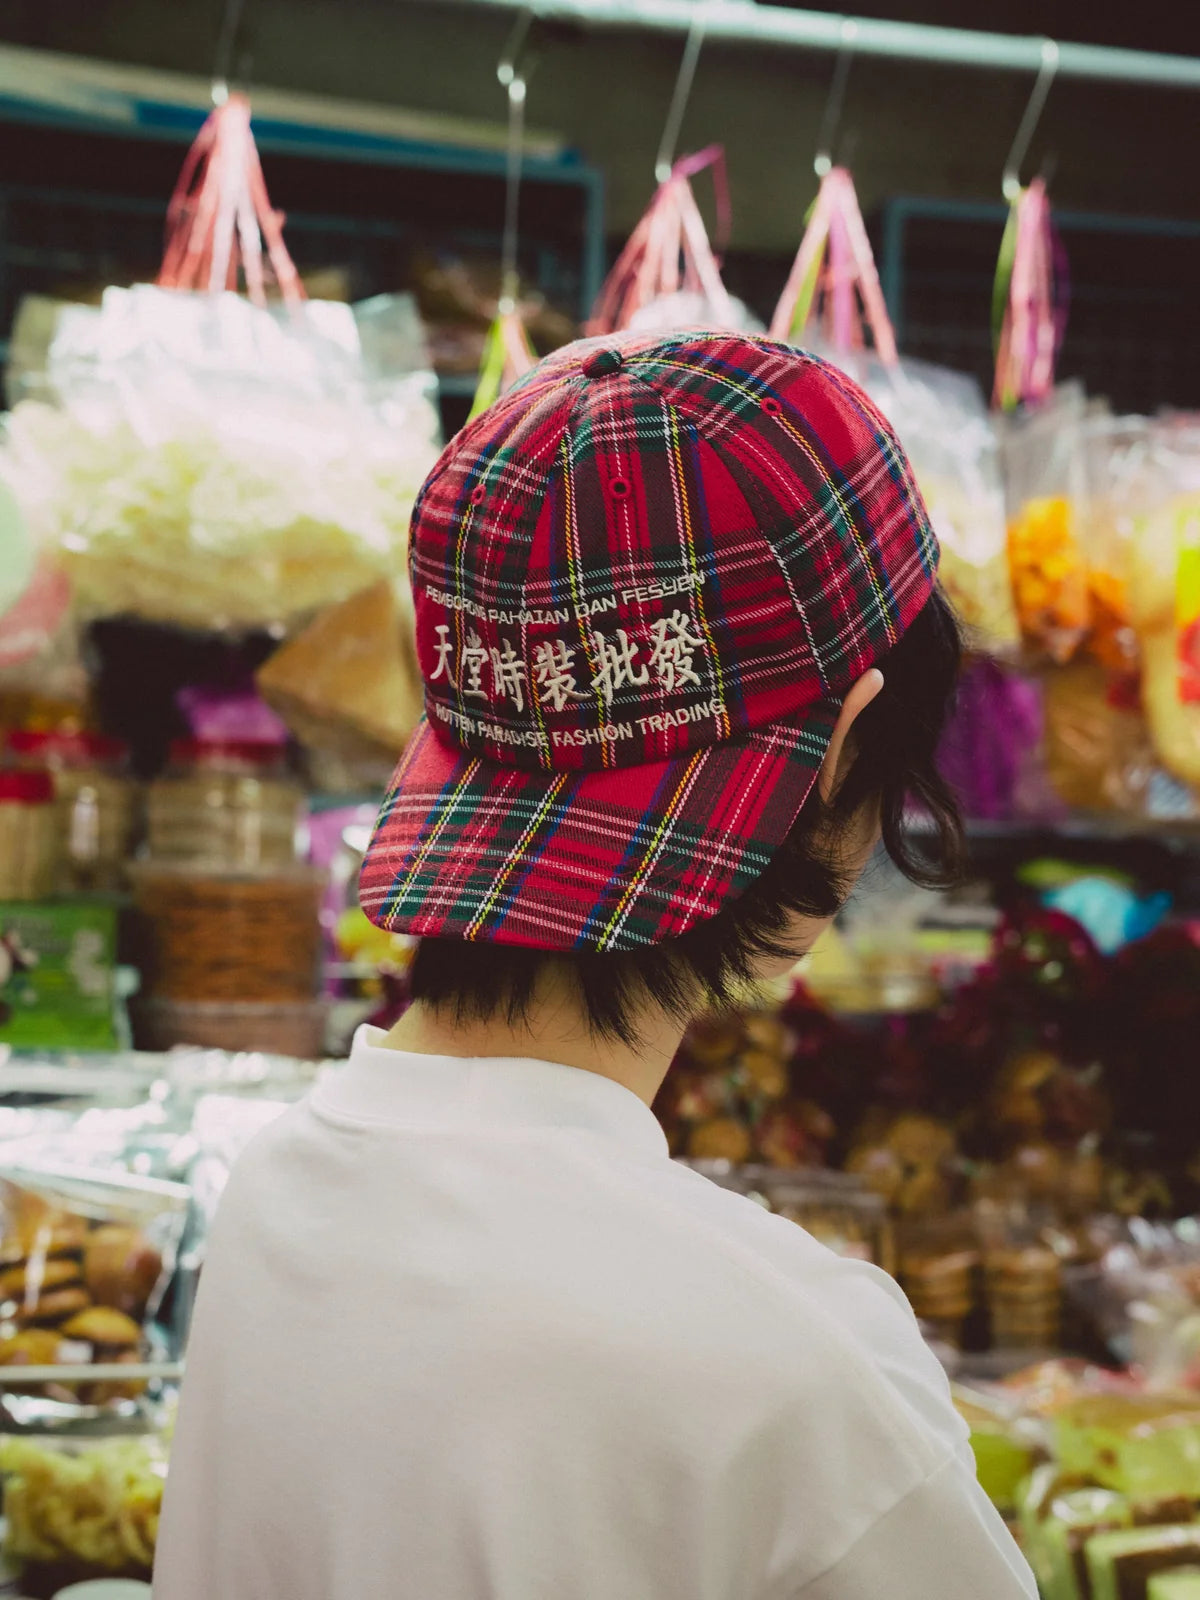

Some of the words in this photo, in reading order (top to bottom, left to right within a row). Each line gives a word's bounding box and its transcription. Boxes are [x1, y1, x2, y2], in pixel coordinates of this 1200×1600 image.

[574, 594, 617, 619] DAN
[621, 569, 706, 605] FESYEN
[430, 609, 706, 712] 天堂時裝批發
[477, 720, 549, 748] PARADISE
[551, 722, 634, 748] FASHION
[635, 698, 726, 735] TRADING
